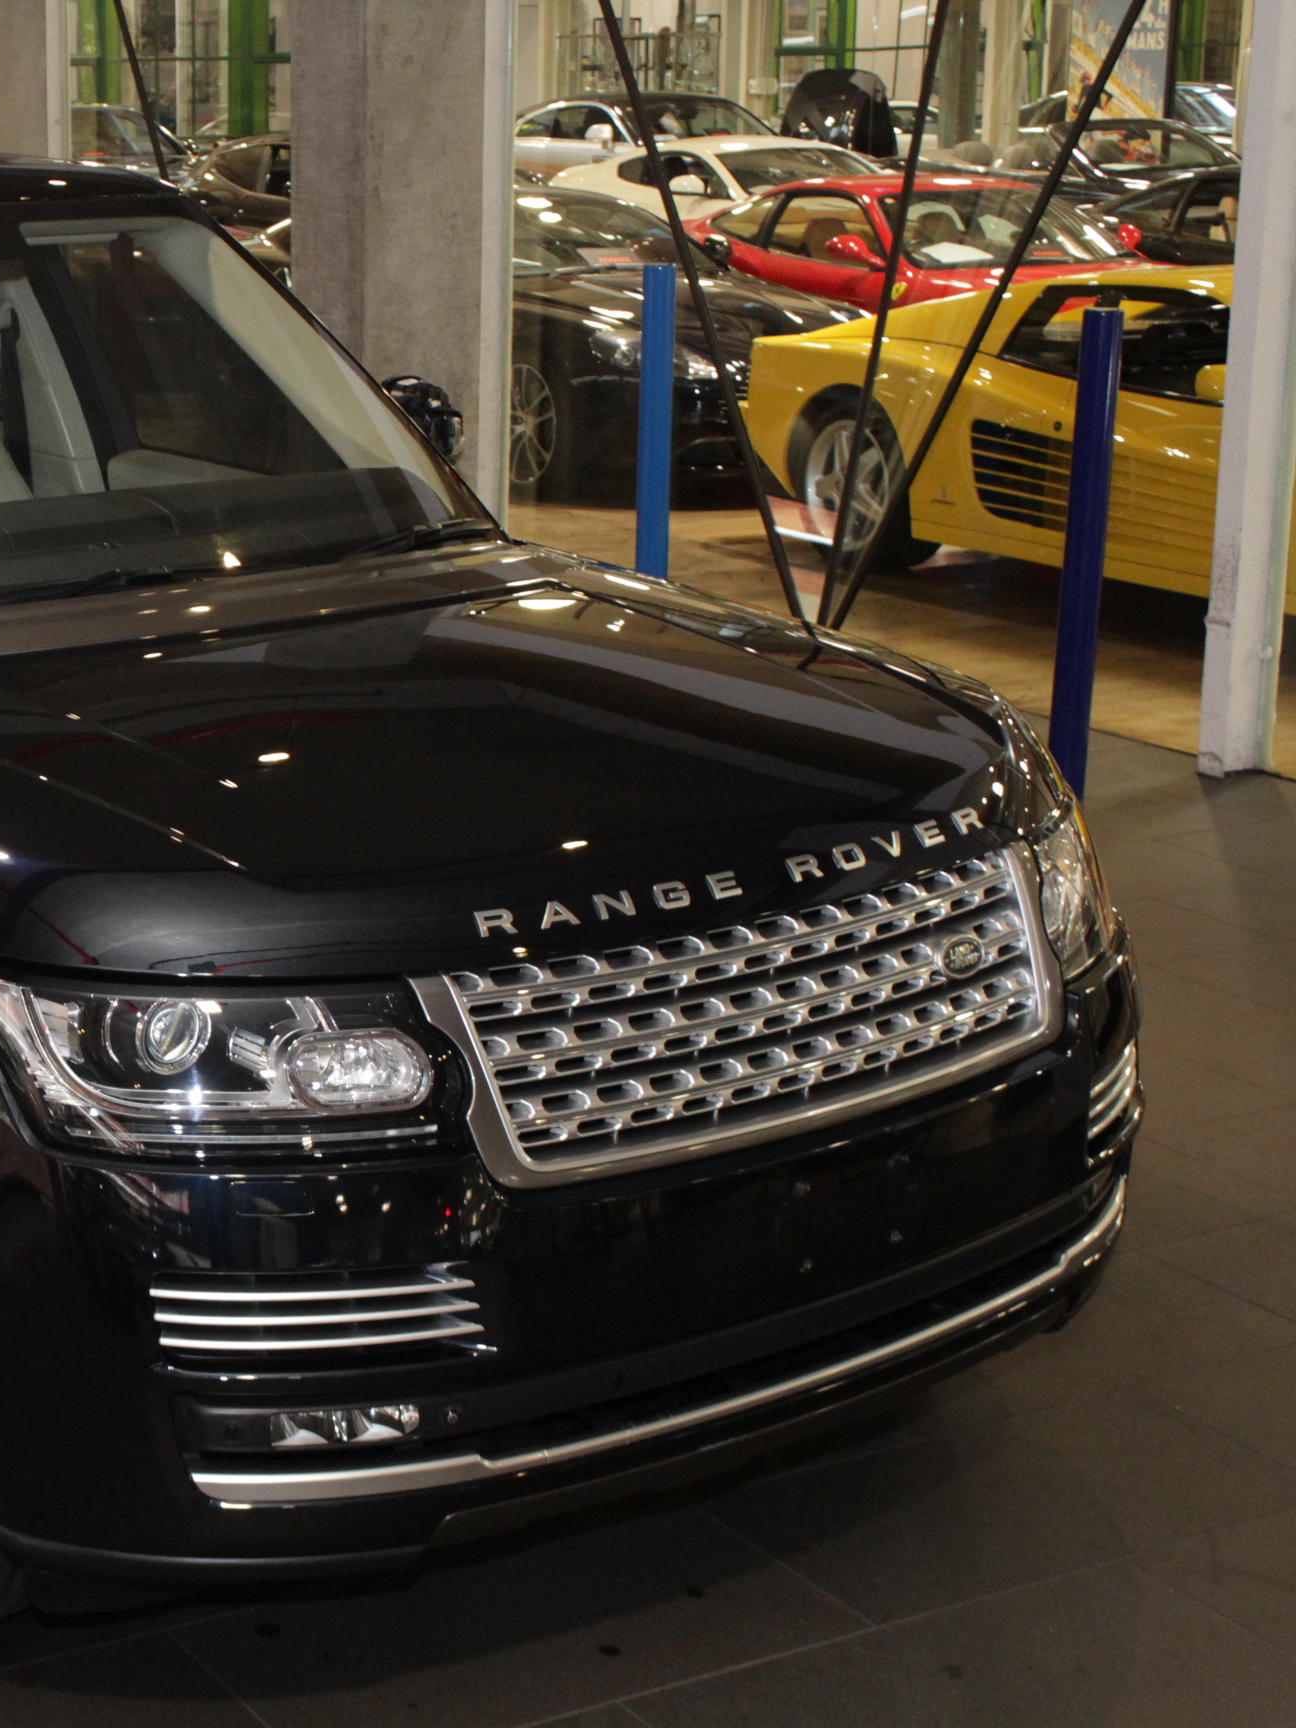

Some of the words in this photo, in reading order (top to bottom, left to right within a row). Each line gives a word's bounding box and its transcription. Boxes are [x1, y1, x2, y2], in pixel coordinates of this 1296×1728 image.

[1125, 31, 1167, 50] MANS
[473, 870, 743, 938] RANGE
[784, 807, 984, 883] ROVER
[949, 943, 971, 960] LAND
[955, 952, 980, 969] ROVER
